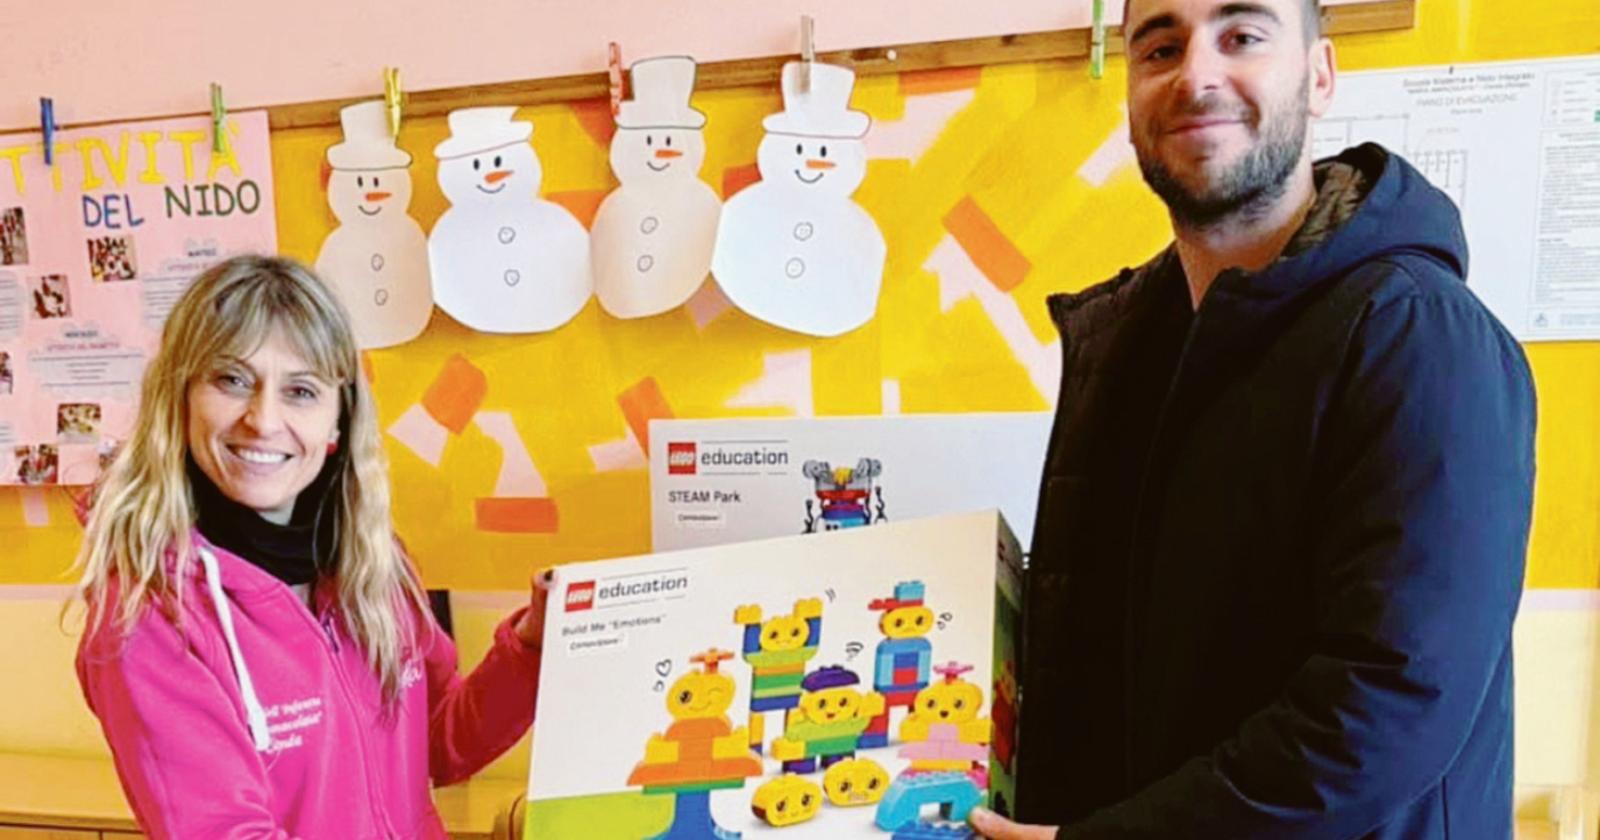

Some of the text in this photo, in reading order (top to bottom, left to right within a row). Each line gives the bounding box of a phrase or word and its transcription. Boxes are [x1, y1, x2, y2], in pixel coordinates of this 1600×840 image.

[82, 180, 260, 229] DEL NIDO
[701, 447, 788, 465] education
[668, 489, 741, 503] STEAM Park
[598, 576, 687, 598] education
[562, 624, 587, 637] Build
[590, 623, 606, 633] Me
